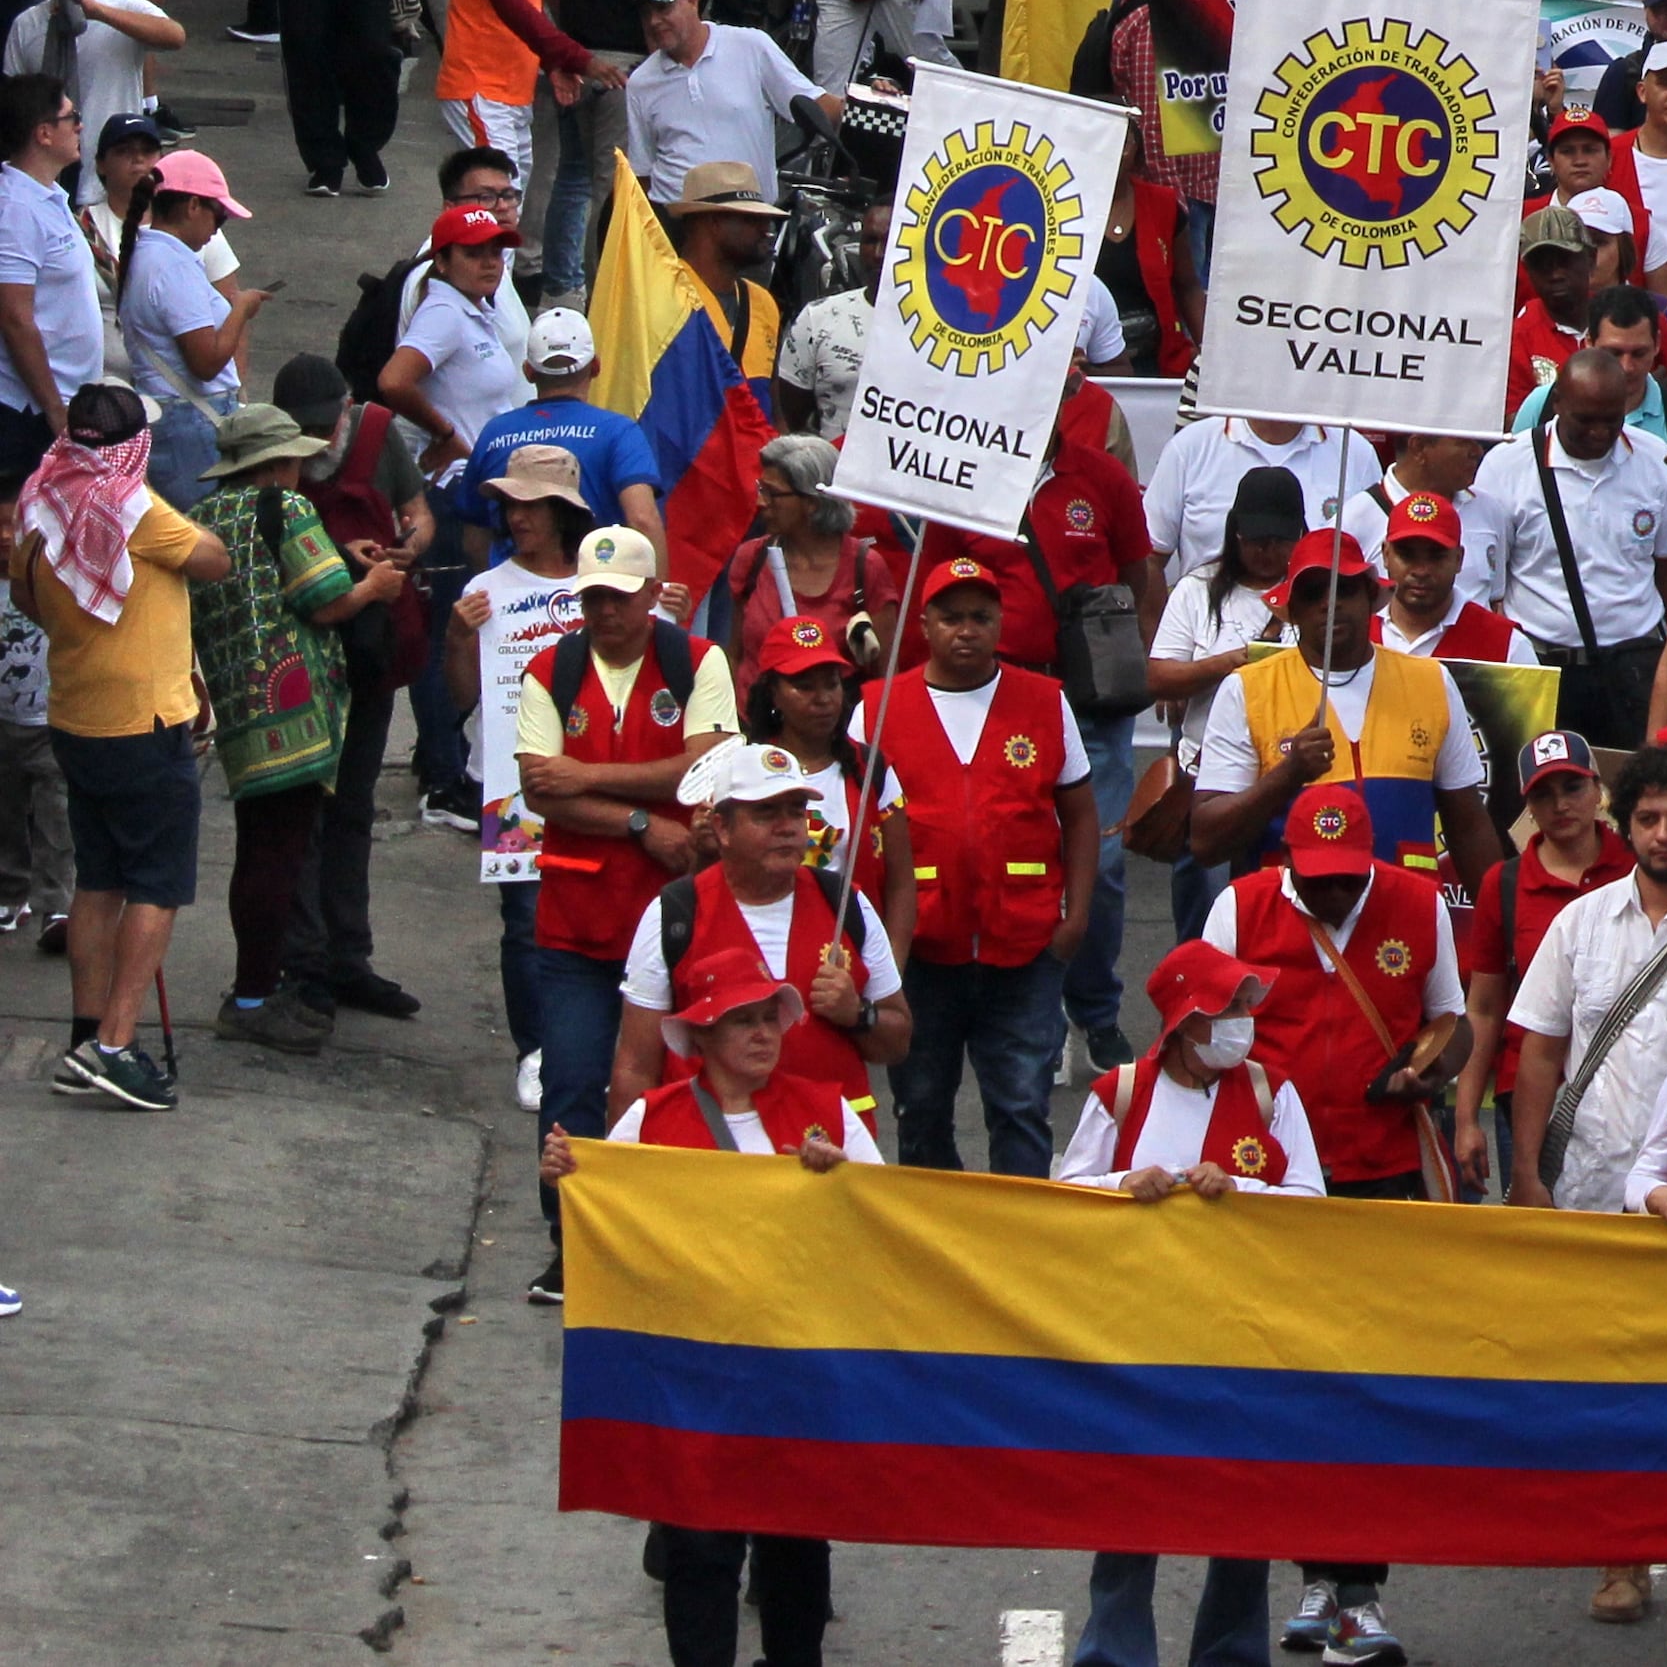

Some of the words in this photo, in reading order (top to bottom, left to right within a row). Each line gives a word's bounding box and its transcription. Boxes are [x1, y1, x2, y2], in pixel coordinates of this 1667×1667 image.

[1281, 47, 1375, 138] CONFEDERACIÓN
[1380, 49, 1399, 63] DE
[1404, 55, 1468, 154] TRABAJADORES
[1307, 110, 1443, 177] CTC
[933, 207, 1037, 280] CTC
[1319, 211, 1339, 229] DE
[1341, 219, 1419, 239] COLOMBIA
[1235, 294, 1483, 346] SECCIONAL
[1286, 339, 1426, 382] VALLE
[860, 385, 1033, 460] SECCIONAL
[886, 436, 979, 490] VALLE
[498, 645, 540, 655] GRACIAS
